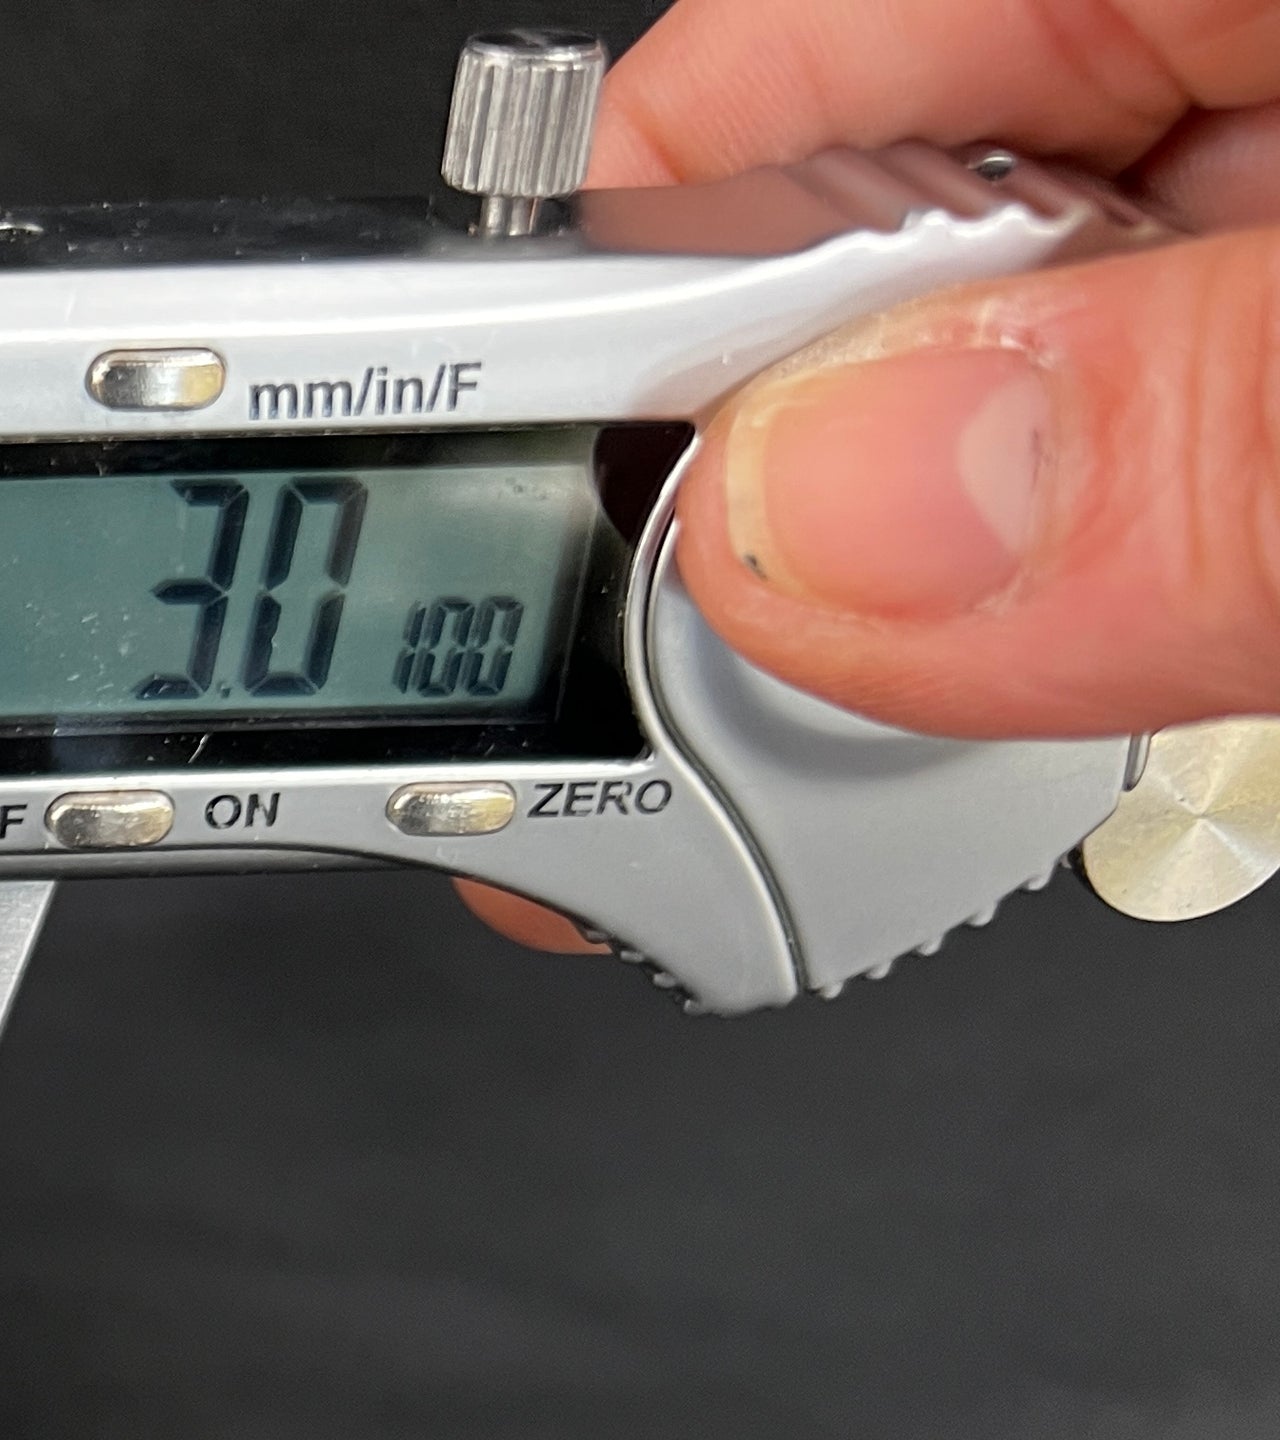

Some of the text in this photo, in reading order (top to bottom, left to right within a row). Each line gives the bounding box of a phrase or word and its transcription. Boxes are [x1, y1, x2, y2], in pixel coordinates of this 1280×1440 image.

[248, 362, 482, 420] mm/in/F
[205, 792, 280, 829] ON
[527, 779, 672, 818] ZERO
